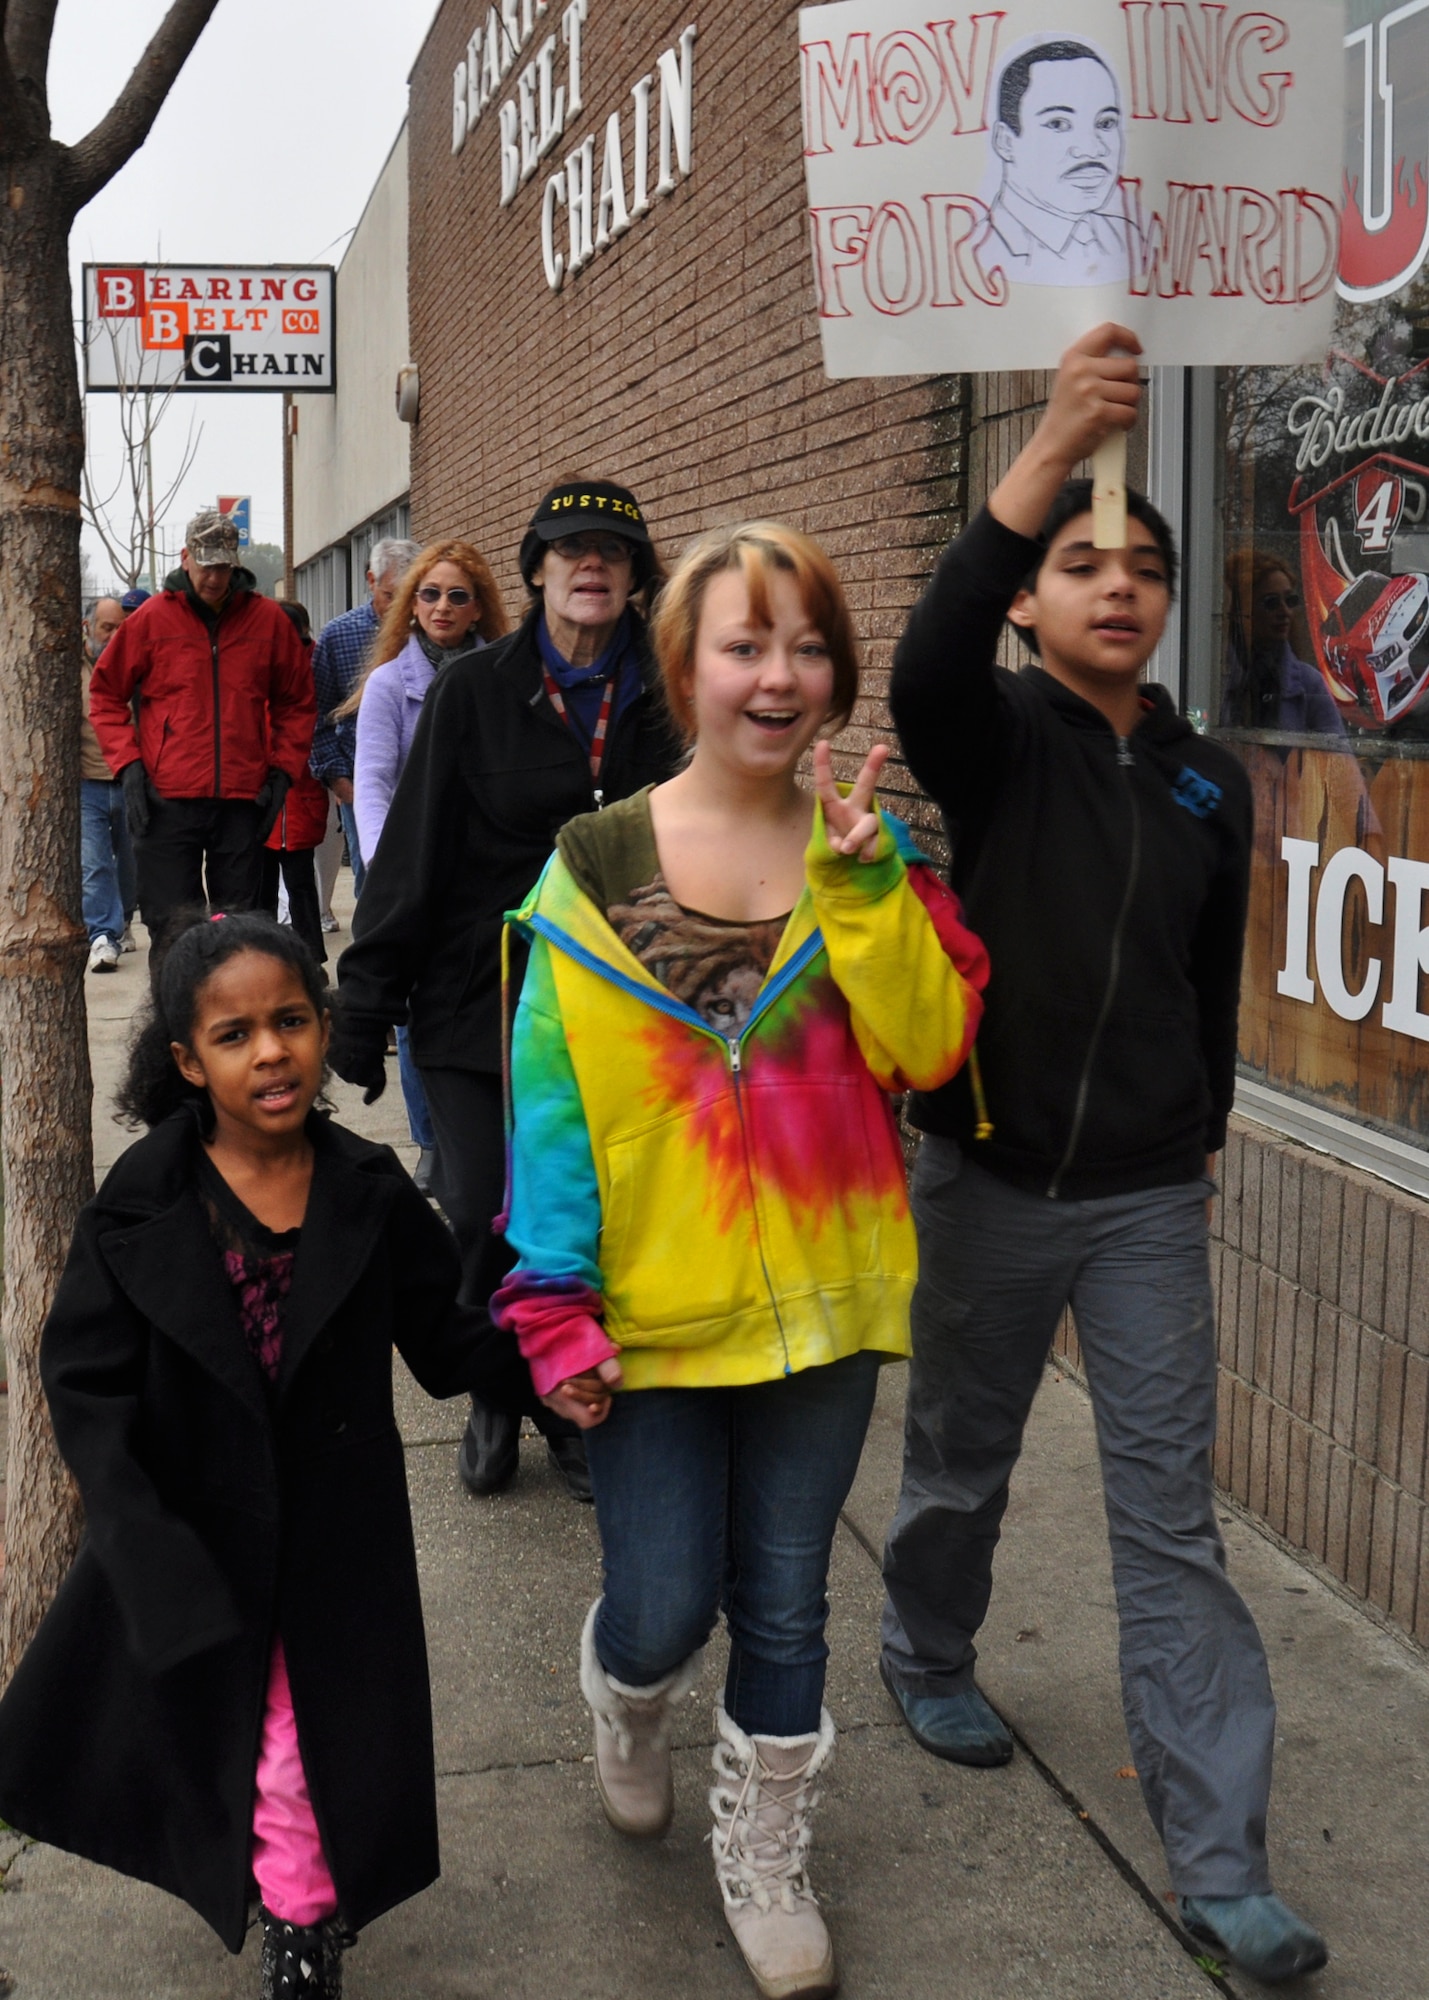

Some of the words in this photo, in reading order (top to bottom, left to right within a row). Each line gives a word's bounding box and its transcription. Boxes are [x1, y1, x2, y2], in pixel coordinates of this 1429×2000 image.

[498, 0, 587, 208] BELT
[799, 11, 1006, 156] MOV
[1121, 1, 1295, 127] ING
[541, 24, 697, 291] CHAIN
[810, 194, 1009, 318] FOR
[1119, 176, 1342, 305] WARD
[102, 276, 318, 310] BEARING
[149, 308, 268, 343] BELT
[284, 311, 319, 331] CO.
[191, 341, 325, 377] CHAIN
[551, 494, 639, 520] JUSTICE
[1357, 481, 1393, 551] 4
